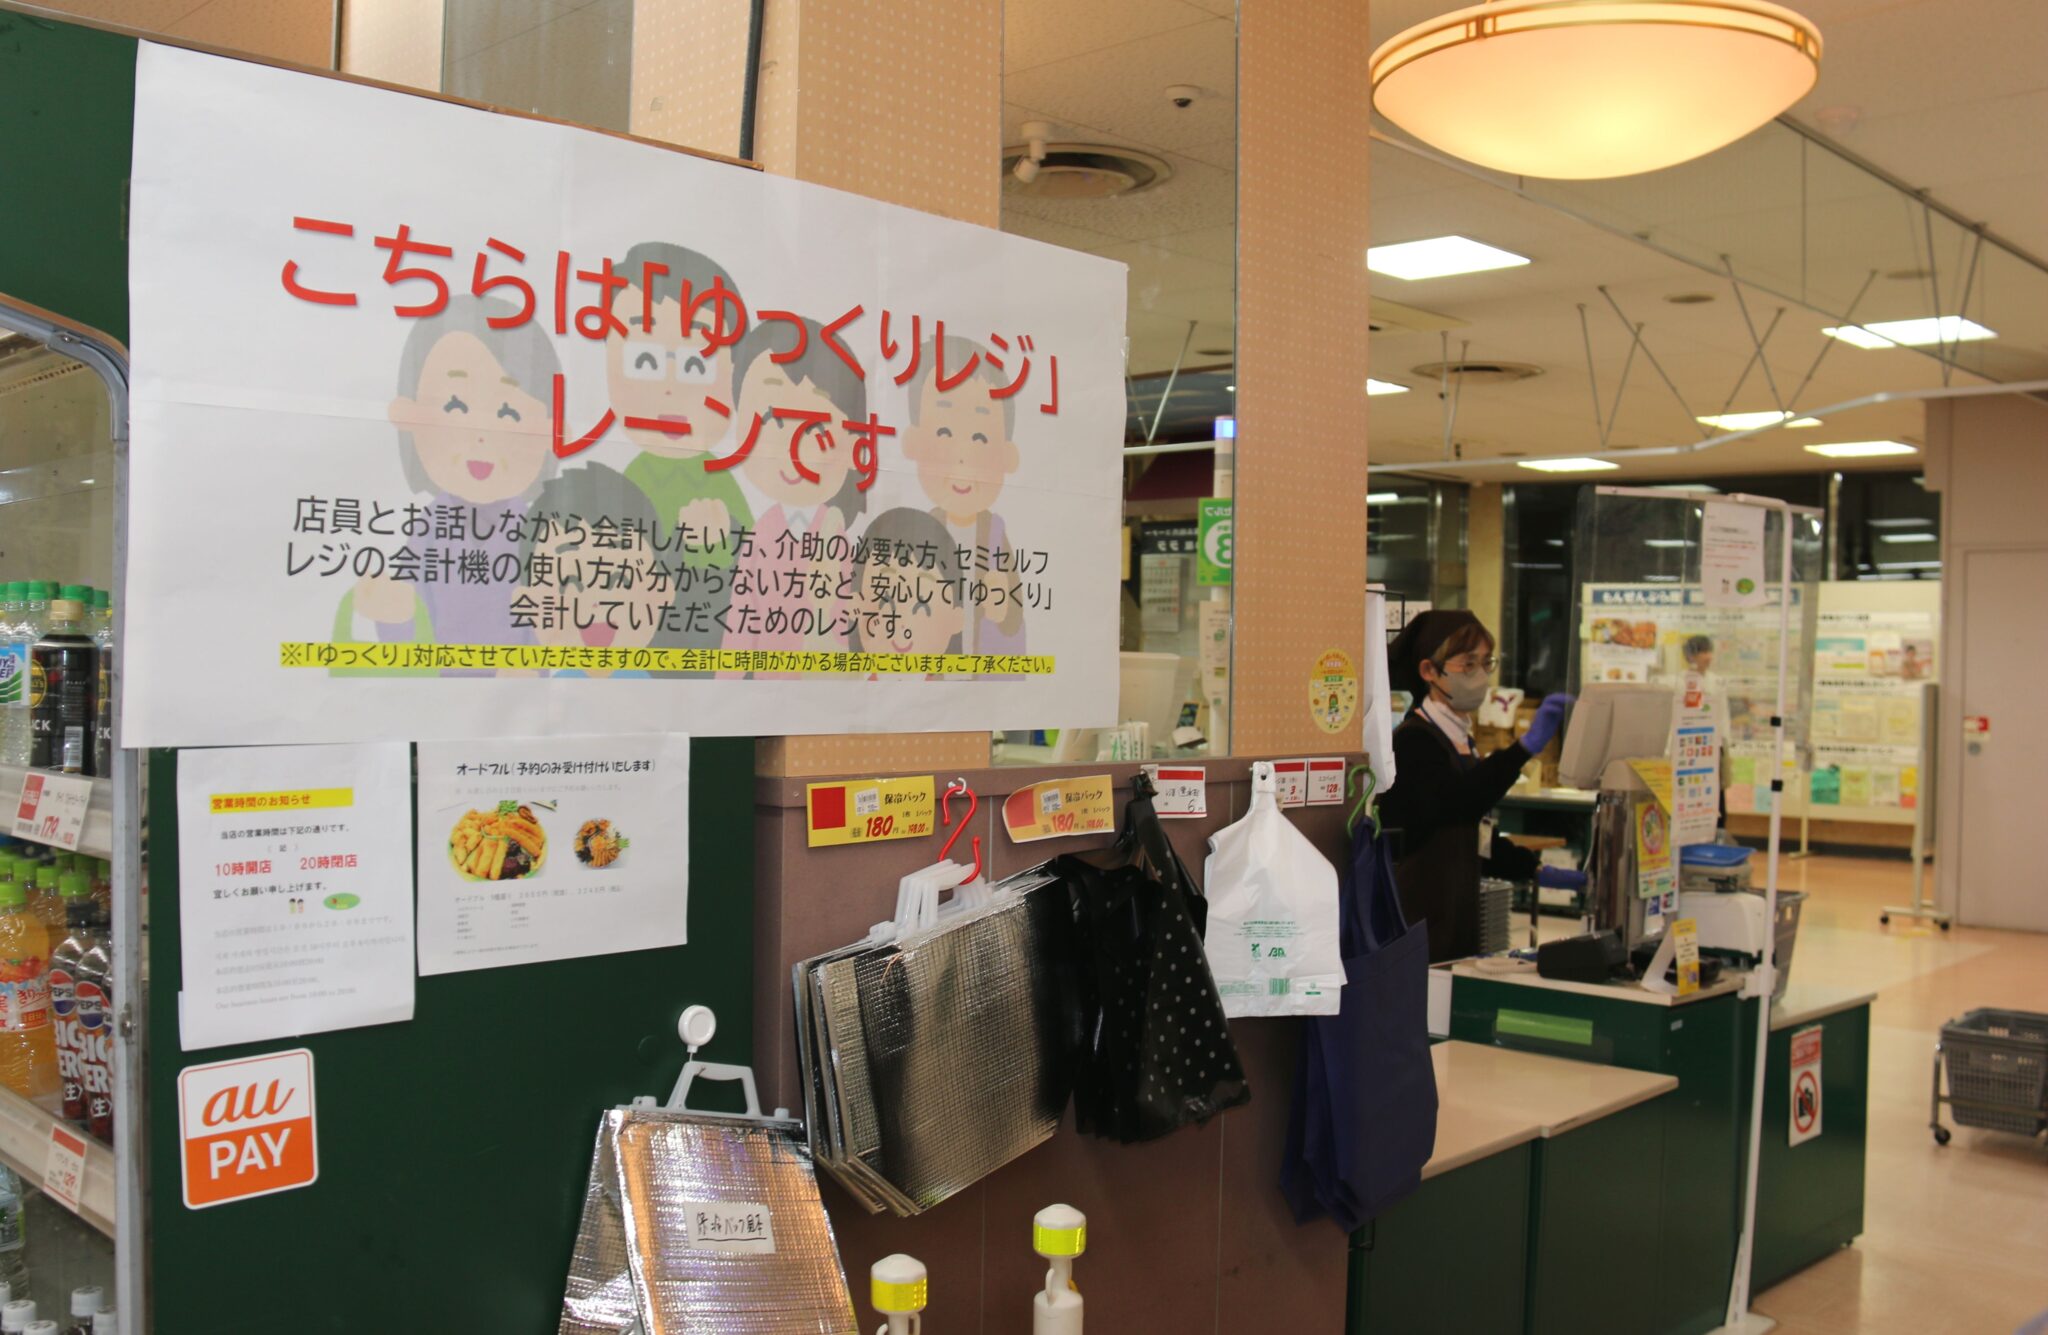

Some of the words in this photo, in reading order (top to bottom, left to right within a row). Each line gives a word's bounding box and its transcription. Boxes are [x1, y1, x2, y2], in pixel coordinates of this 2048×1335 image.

[282, 216, 1058, 415] こちらは「ゆっくりレジ」
[552, 373, 896, 492] レーンです
[293, 496, 1049, 576] 店員とお話しながら会計したい方、介助の必要な方、セミセルフ
[286, 541, 1053, 611] レジの会計機の使い方が分からない方など、安心して「ゆっくり」
[509, 595, 913, 641] 会計していただくためのレジです。
[212, 794, 311, 810] 営業時間のお知らせ
[866, 815, 894, 837] 180
[215, 860, 272, 876] 10時開店
[300, 854, 358, 870] 20時閉店
[202, 1078, 295, 1127] au
[209, 1127, 291, 1180] PAY
